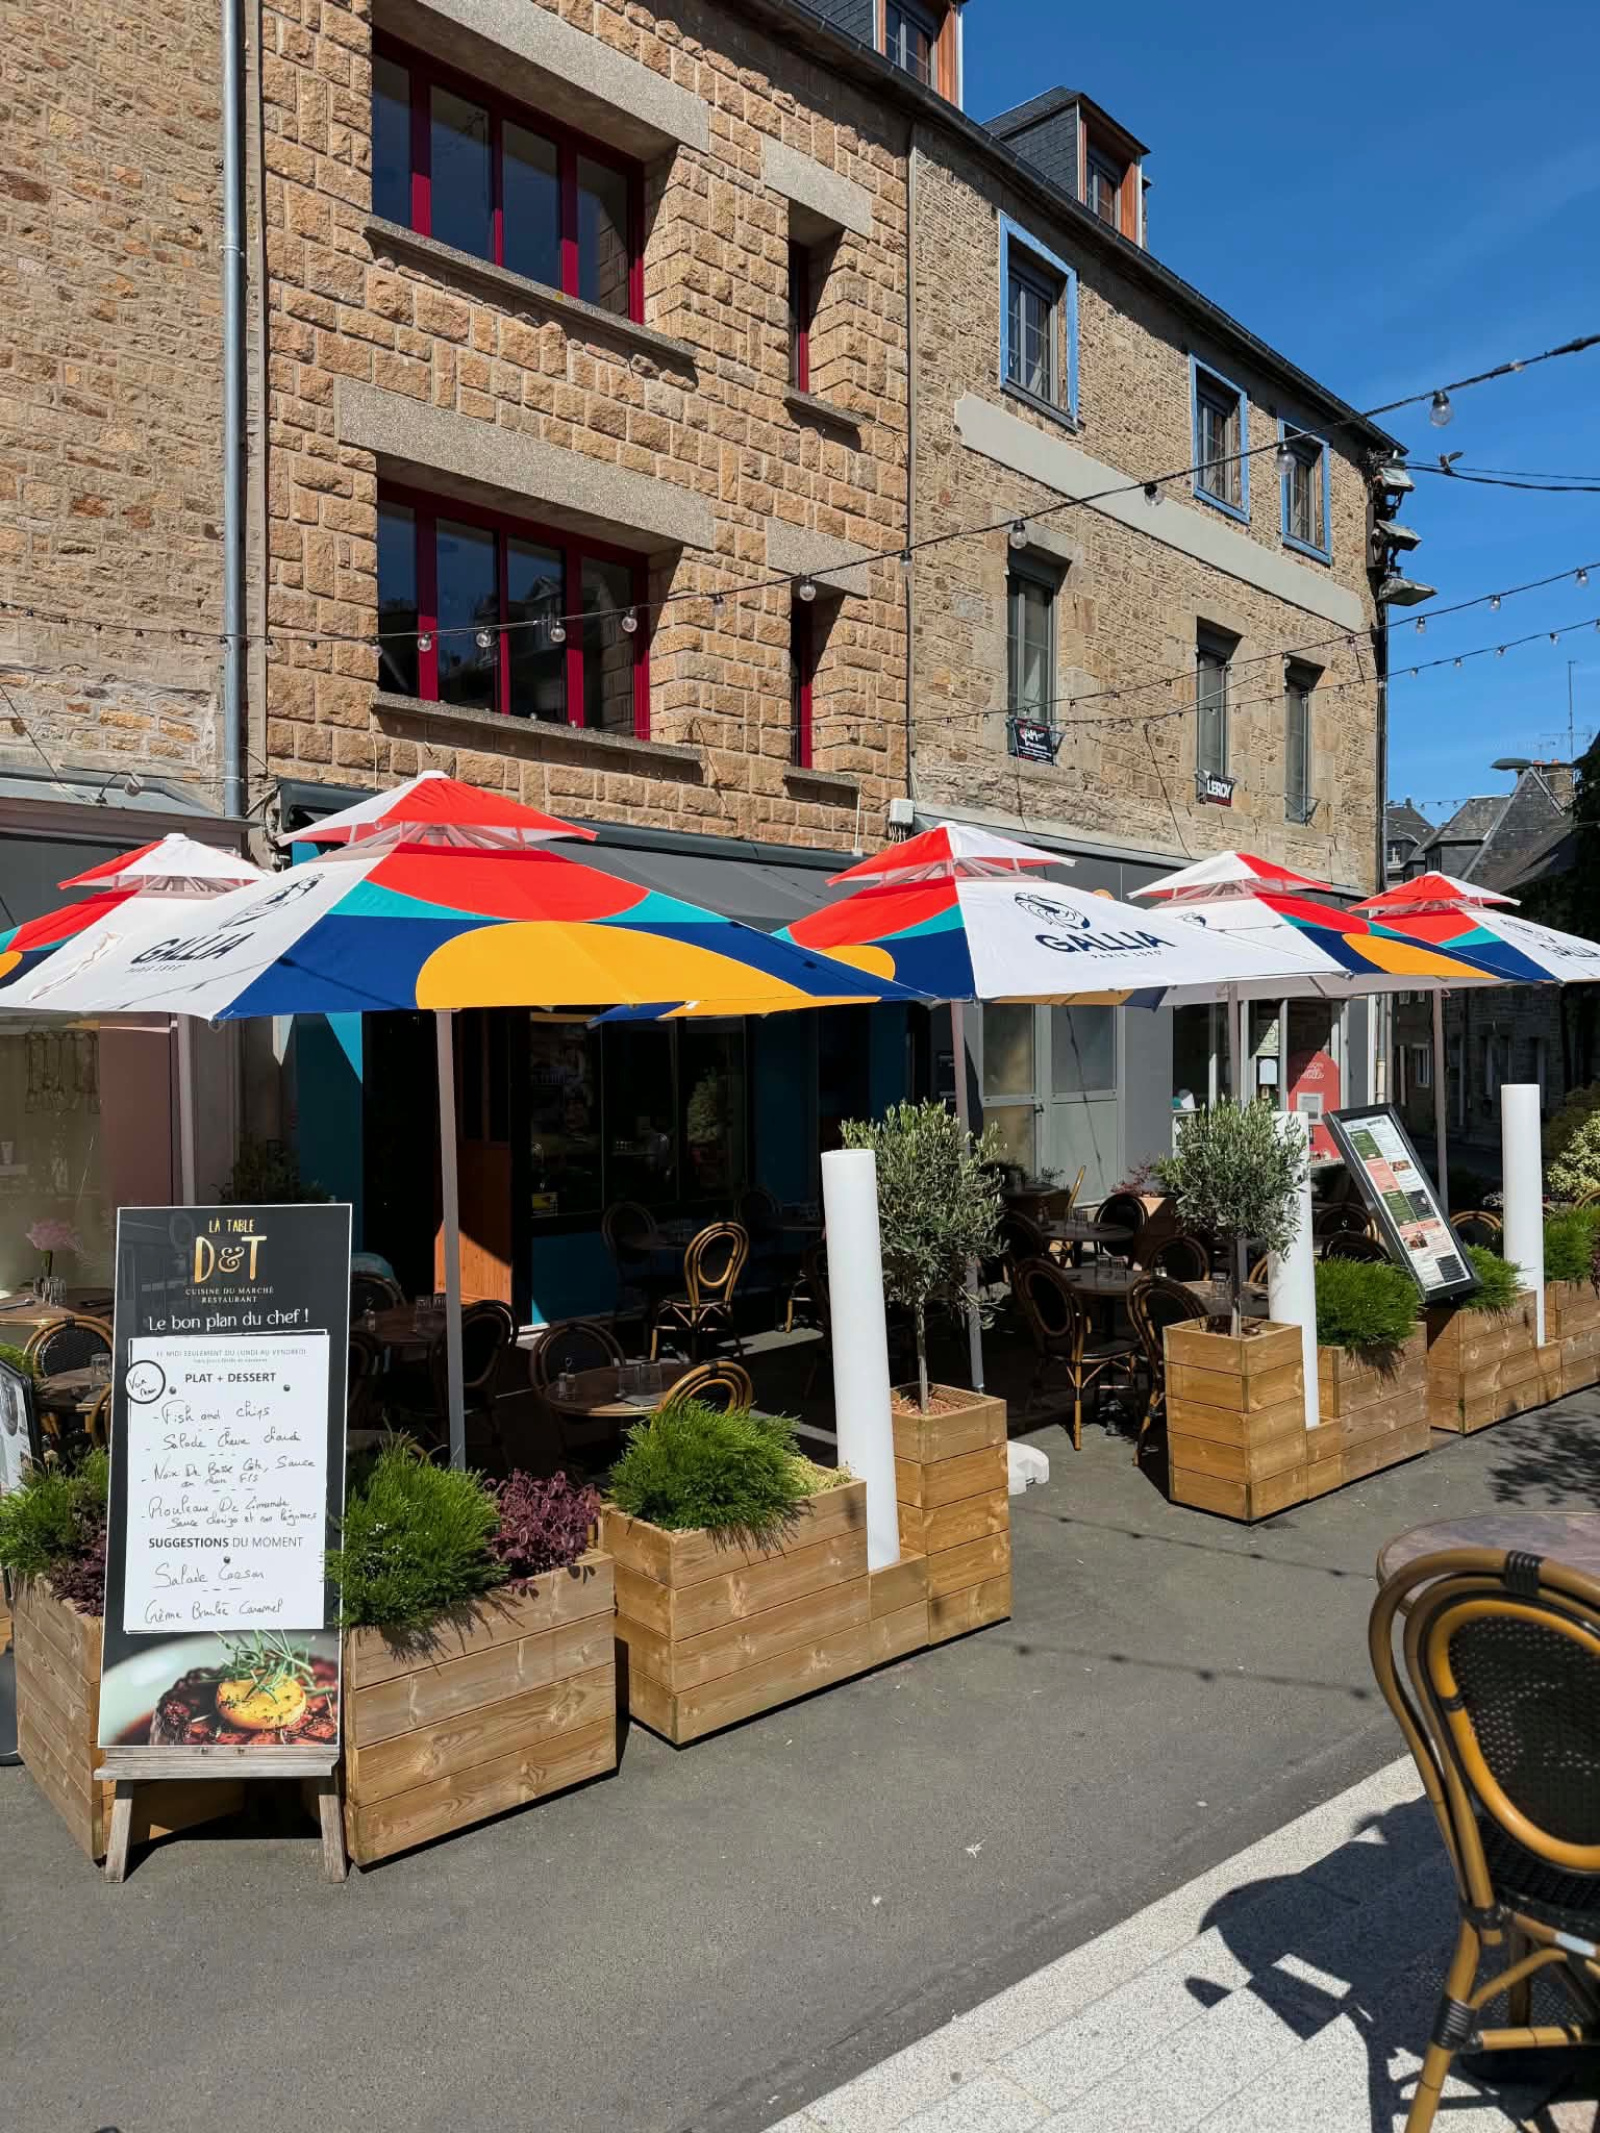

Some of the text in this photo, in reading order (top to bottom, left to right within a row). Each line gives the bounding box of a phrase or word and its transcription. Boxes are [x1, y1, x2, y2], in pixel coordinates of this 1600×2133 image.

[1207, 779, 1232, 799] LEROY
[130, 932, 256, 964] GALLIA
[1035, 930, 1178, 953] GALLIA
[227, 1218, 256, 1233] TABLE
[194, 1236, 268, 1283] D&T
[185, 1287, 220, 1296] CUISINE
[223, 1286, 236, 1295] DU
[201, 1296, 257, 1304] RESTAURANT
[149, 1316, 166, 1331] Le
[171, 1313, 201, 1330] bon
[206, 1312, 237, 1331] plan
[242, 1311, 262, 1326] du
[267, 1309, 301, 1325] chef
[185, 1373, 212, 1383] PLAT
[227, 1372, 277, 1383] DESSERT
[201, 1409, 221, 1420] and
[149, 1536, 304, 1549] SUGGESTIONS DU MOMENT
